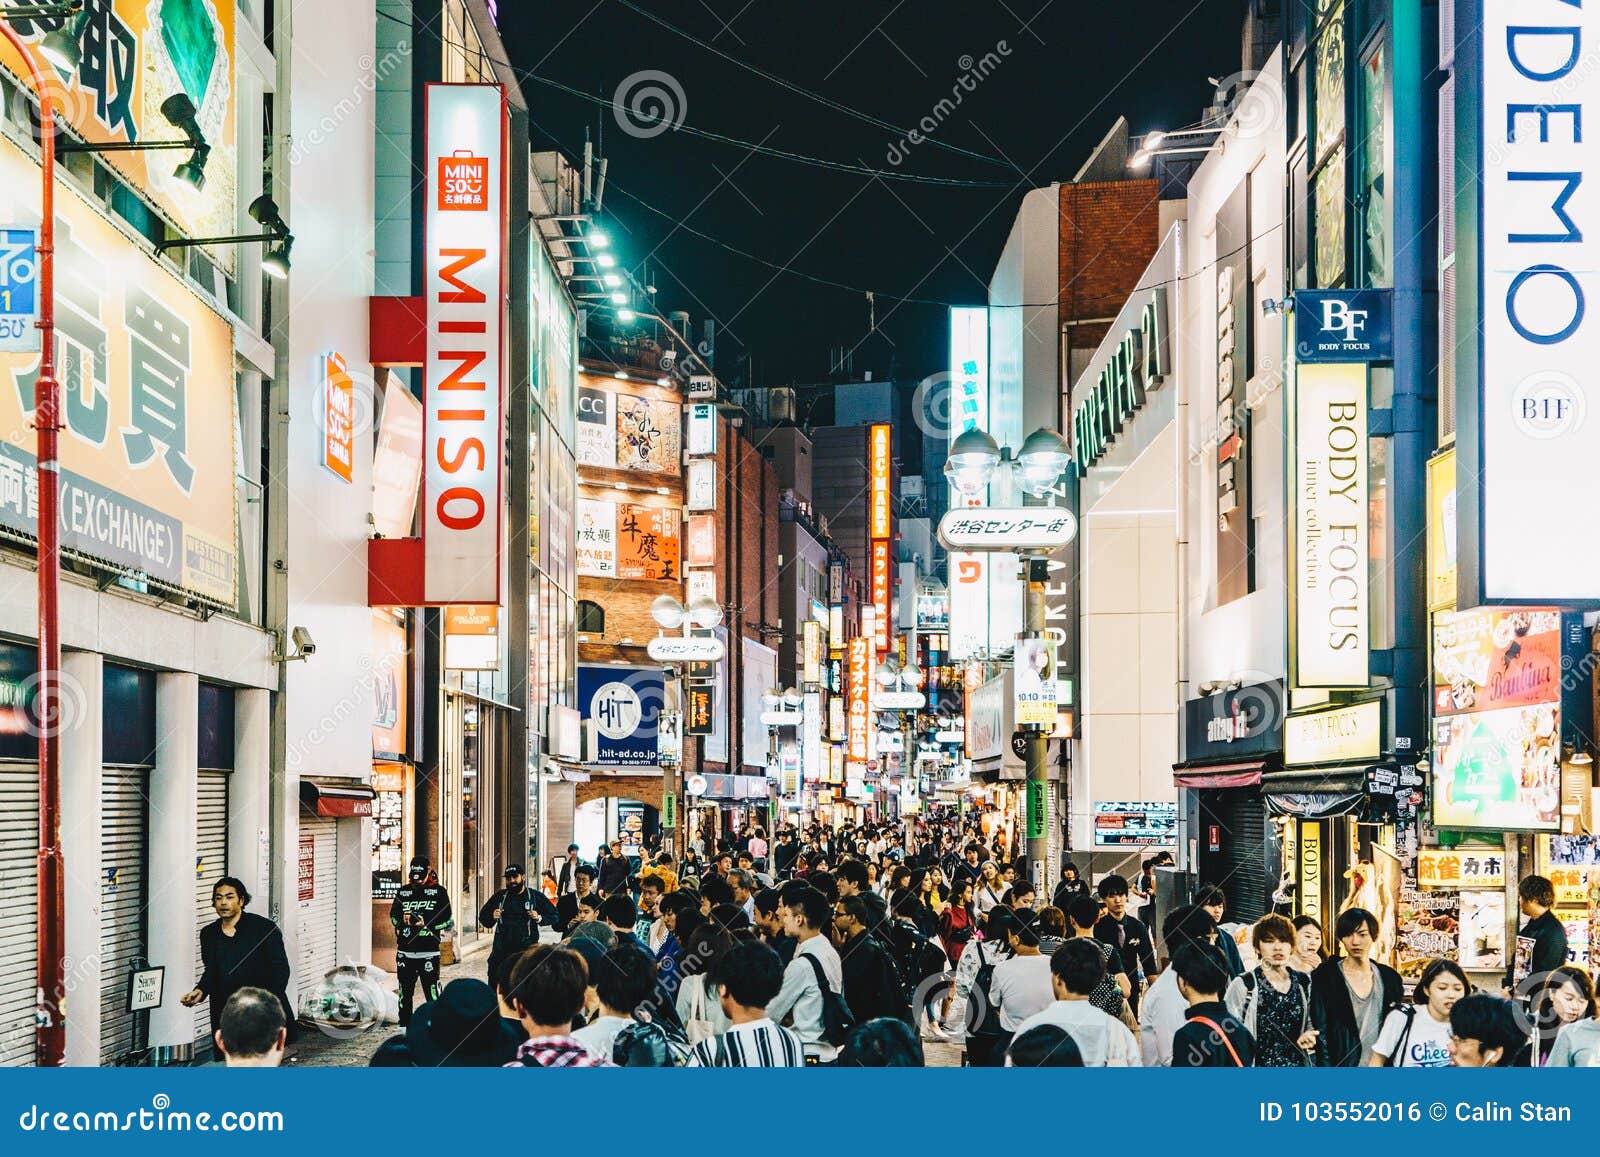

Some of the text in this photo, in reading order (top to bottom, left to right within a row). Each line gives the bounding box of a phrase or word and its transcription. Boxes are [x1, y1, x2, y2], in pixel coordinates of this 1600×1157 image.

[445, 165, 482, 179] MINI
[1505, 0, 1585, 345] DEMO
[1319, 300, 1368, 341] BF
[437, 248, 487, 531] MINISO
[1074, 290, 1171, 478] FOREVER 21
[621, 514, 678, 581] 牛魔王
[949, 518, 1068, 534] 渋谷センター街
[1327, 401, 1359, 650] BODY FOCUS
[1303, 838, 1318, 886] BODY
